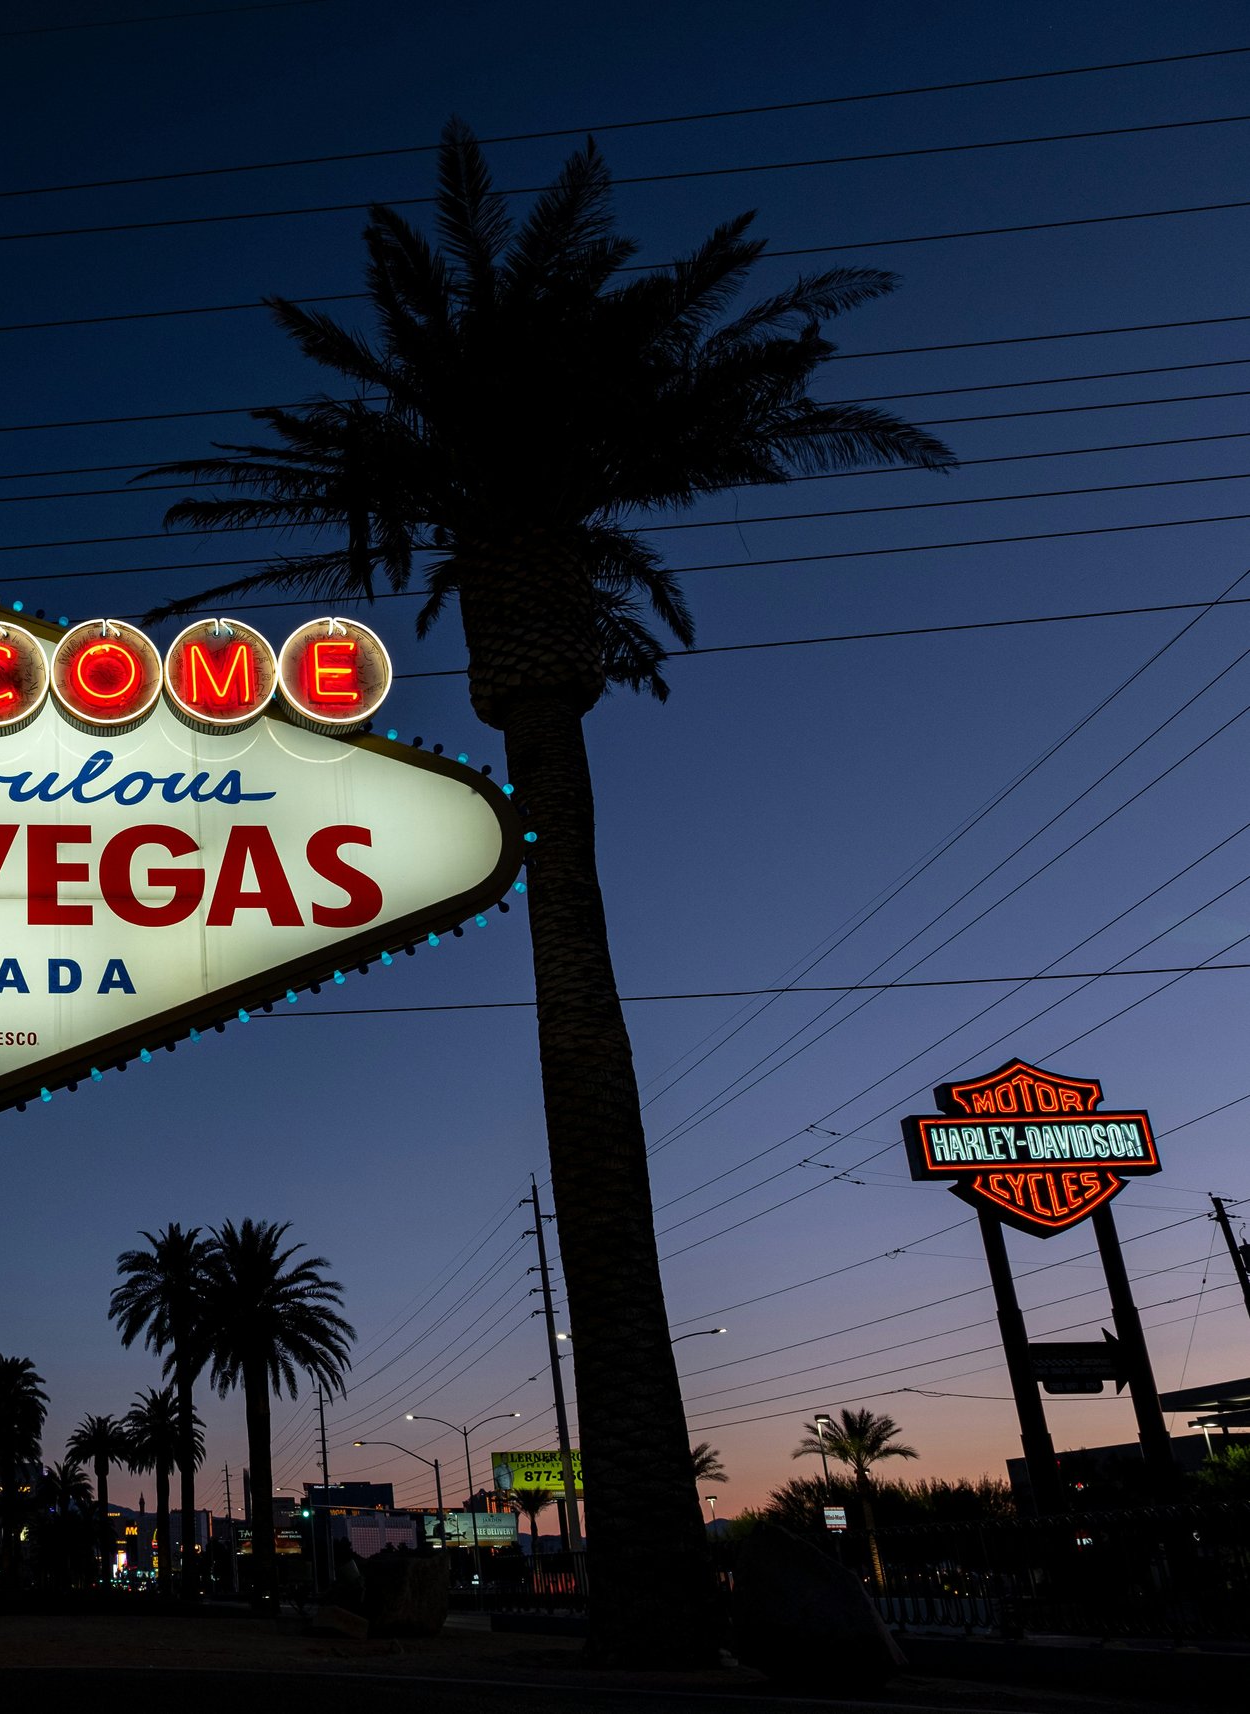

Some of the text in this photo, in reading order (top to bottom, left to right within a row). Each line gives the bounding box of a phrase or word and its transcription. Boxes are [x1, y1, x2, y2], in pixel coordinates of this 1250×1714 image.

[972, 1074, 1084, 1113] MOTOR
[930, 1123, 1144, 1162] HARLEY-DAVIDSON
[989, 1172, 1100, 1216] CYCLES
